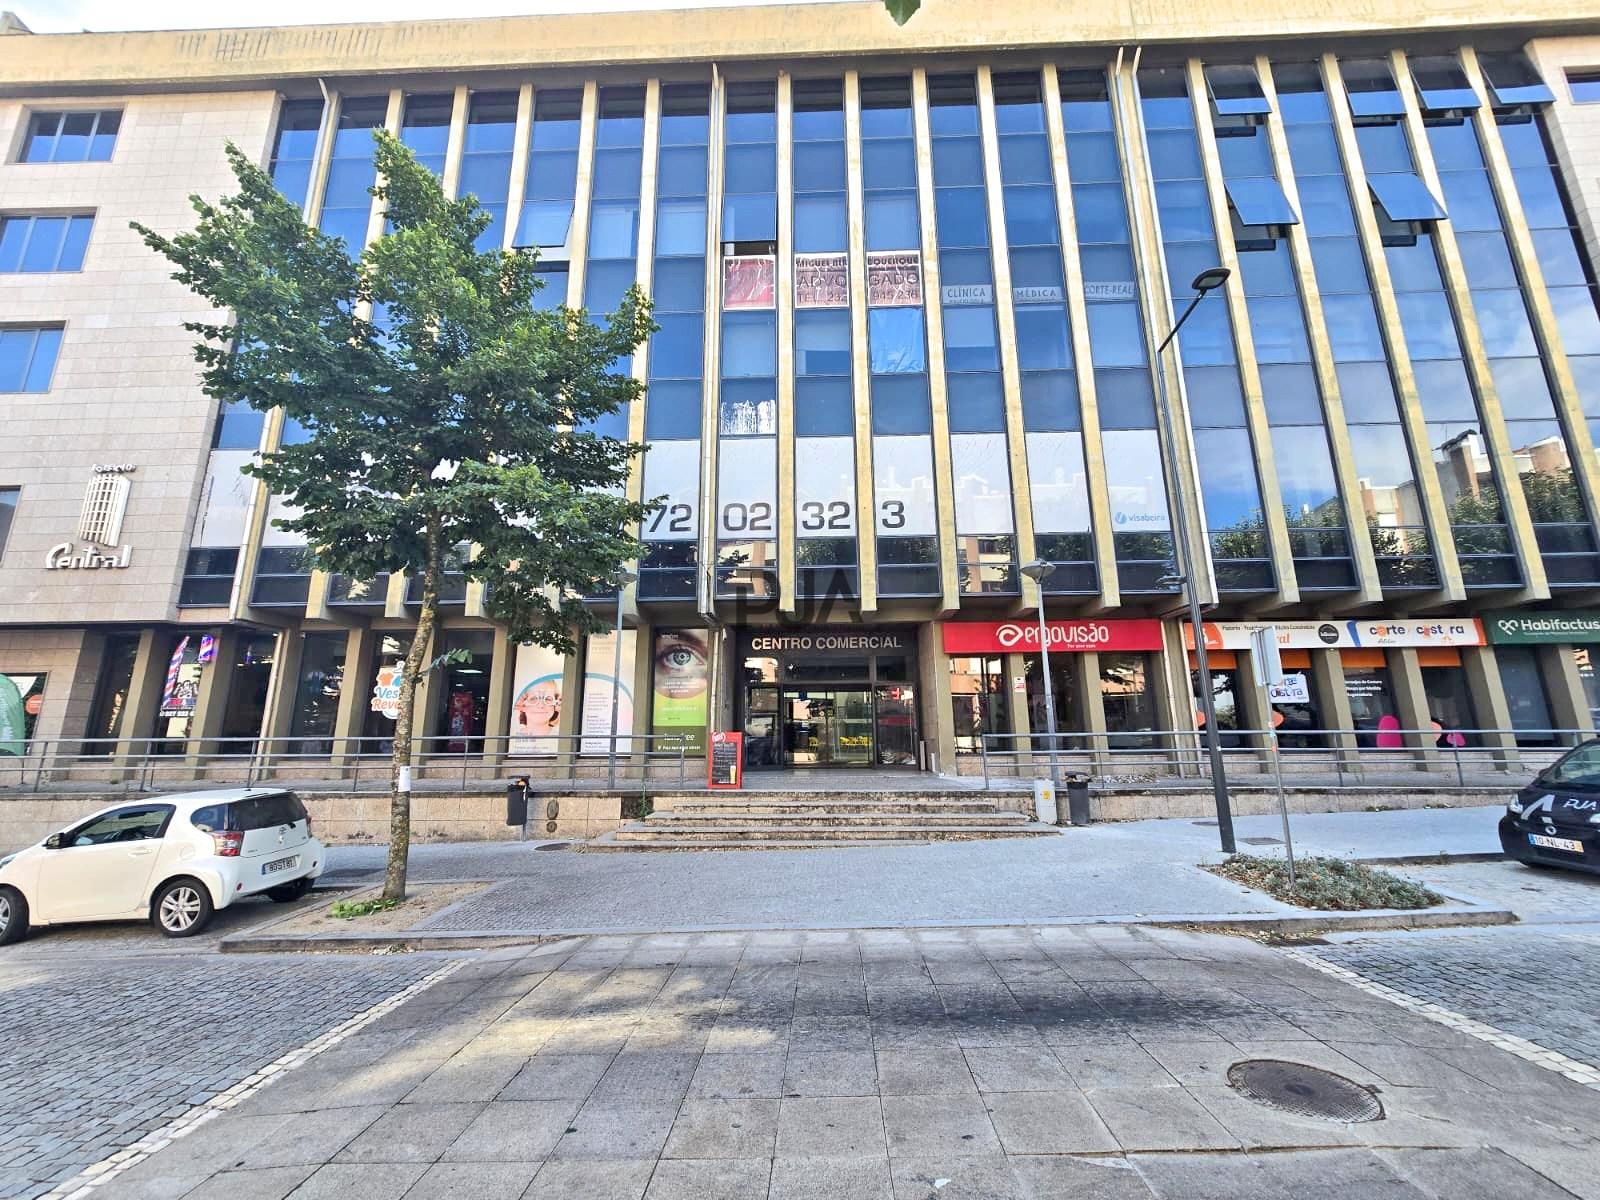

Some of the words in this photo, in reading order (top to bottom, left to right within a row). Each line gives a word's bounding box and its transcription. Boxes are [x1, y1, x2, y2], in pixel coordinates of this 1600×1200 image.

[723, 502, 772, 532] 02
[801, 501, 851, 531] 32
[881, 500, 906, 529] 3
[45, 543, 133, 570] Central
[1520, 619, 1600, 631] Habifactus
[751, 637, 812, 650] CENTRO
[816, 636, 902, 650] COMERCIAL
